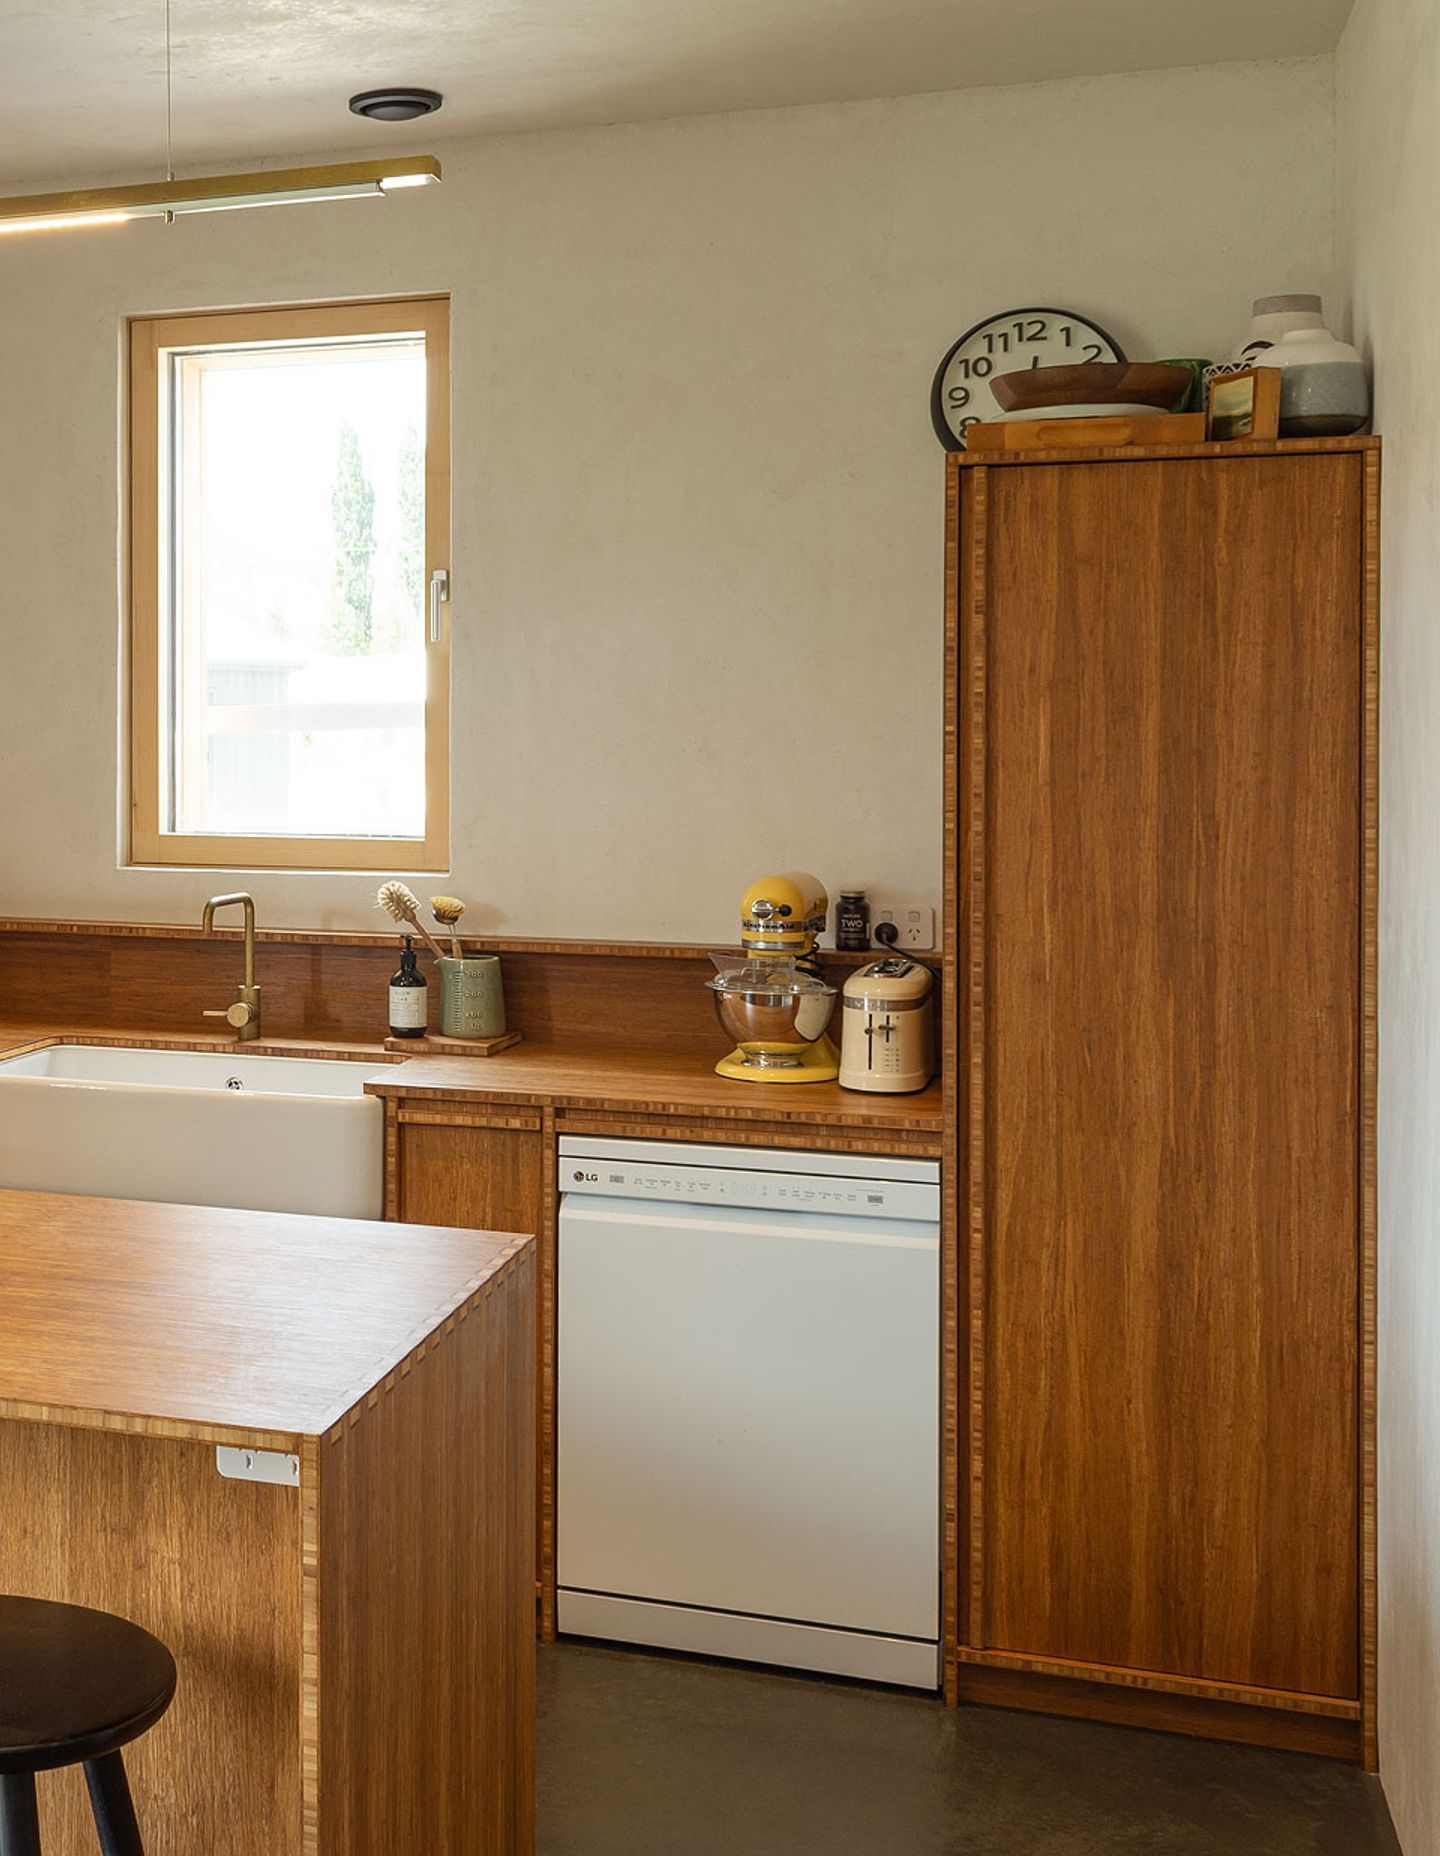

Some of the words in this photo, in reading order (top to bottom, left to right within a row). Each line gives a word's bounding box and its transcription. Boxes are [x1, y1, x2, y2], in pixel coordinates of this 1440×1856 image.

[1012, 319, 1048, 342] 12
[1059, 326, 1071, 347] 1
[982, 332, 1009, 354] 11
[1081, 344, 1103, 364] 2
[958, 356, 992, 379] 10
[948, 386, 970, 409] 9
[841, 919, 863, 928] TWO
[586, 1173, 599, 1182] LG
